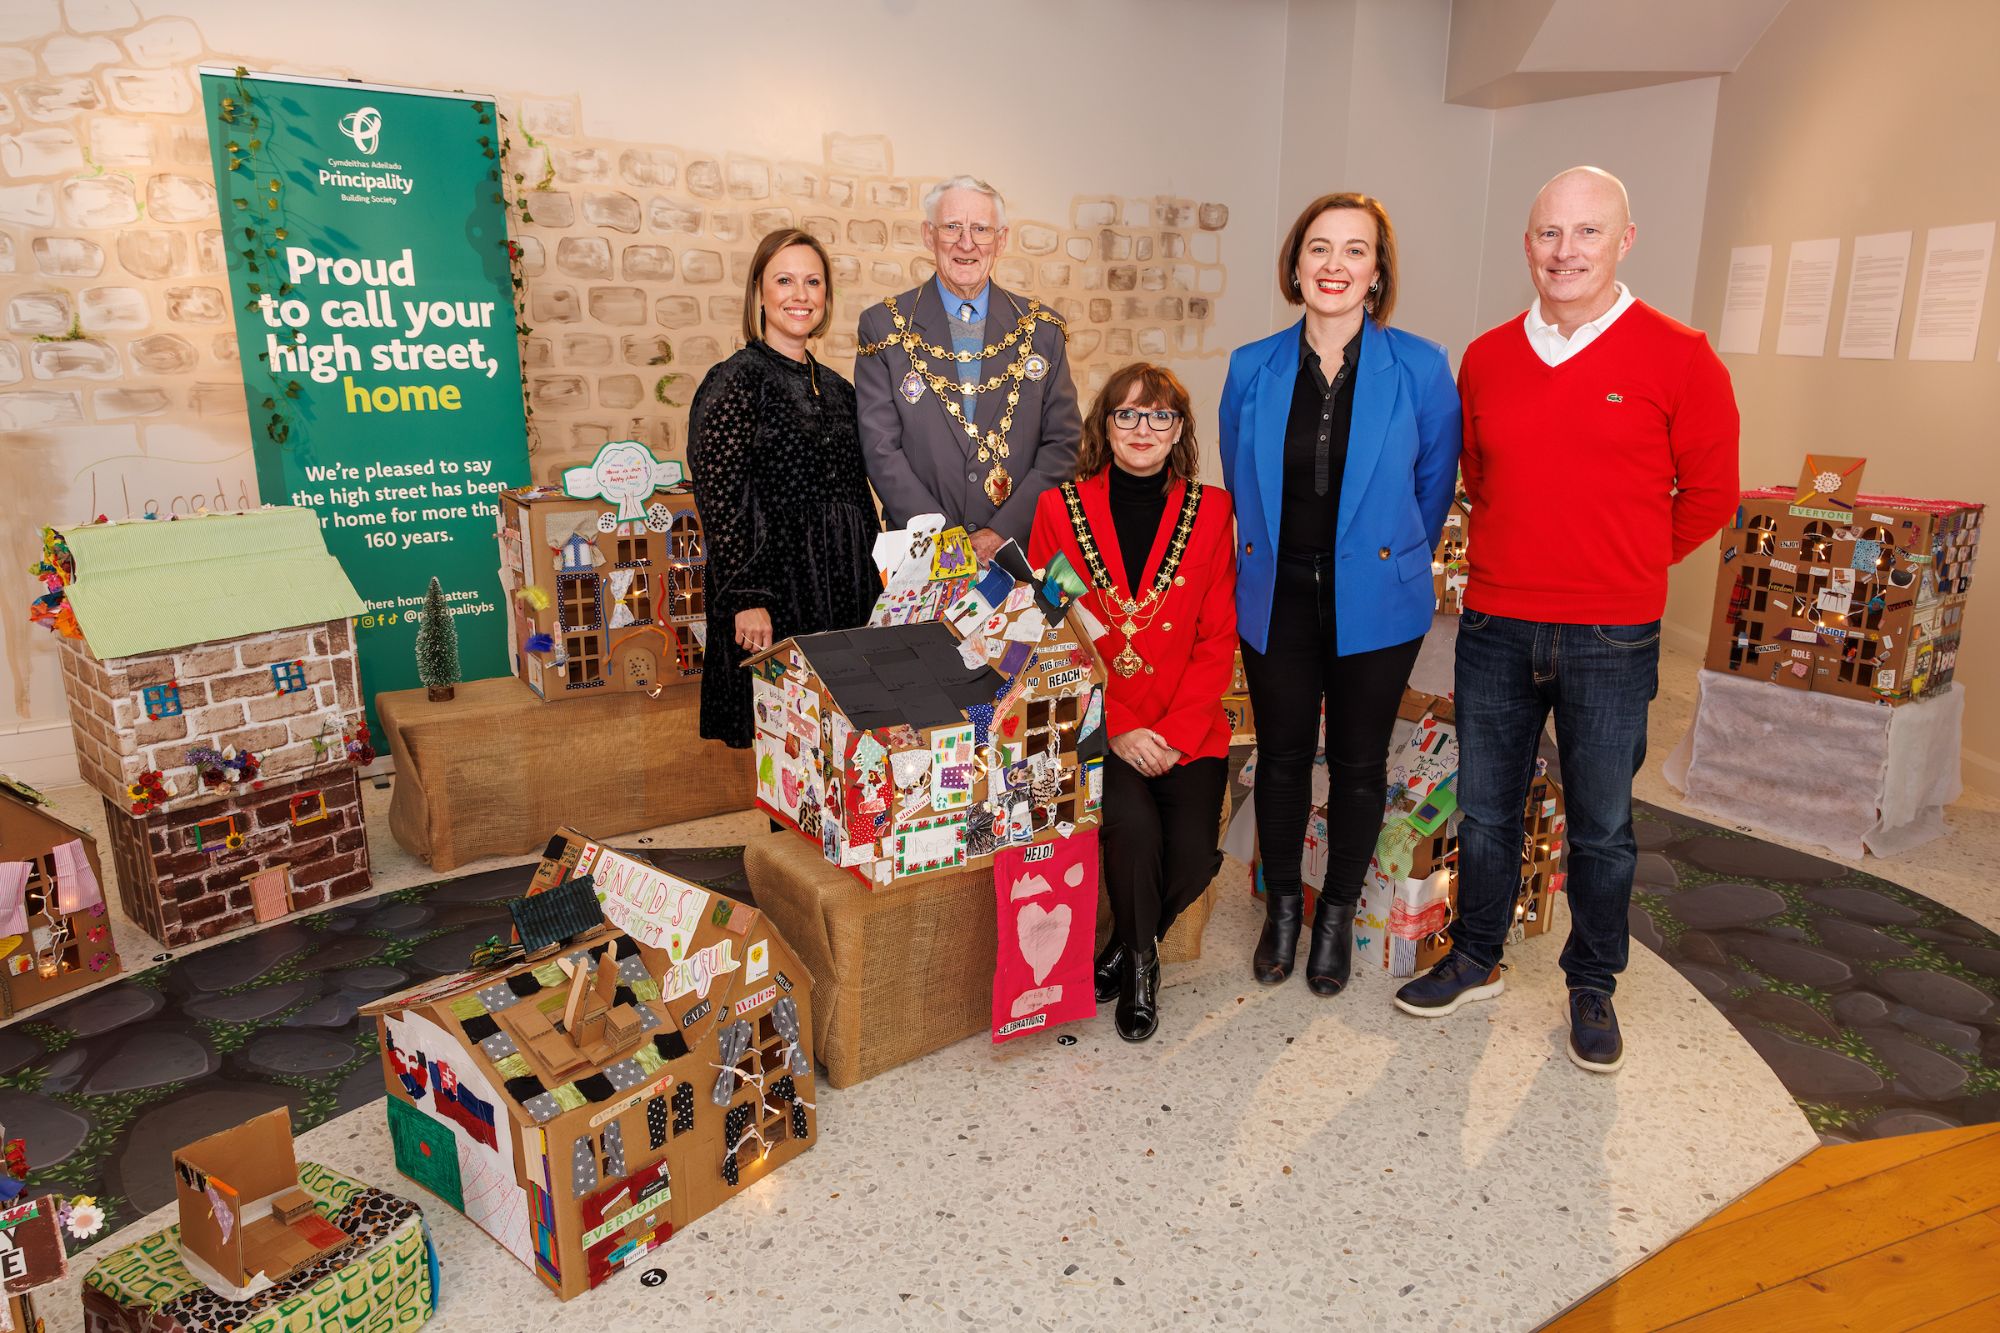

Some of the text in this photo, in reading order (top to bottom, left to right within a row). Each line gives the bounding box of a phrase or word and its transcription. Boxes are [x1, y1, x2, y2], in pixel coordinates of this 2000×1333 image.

[328, 158, 402, 170] Cymdeithas Adeiladu
[319, 169, 413, 194] Principality
[341, 193, 397, 205] Building Society
[286, 247, 416, 287] Proud
[258, 289, 495, 339] to call your
[266, 333, 499, 383] high street,
[343, 375, 463, 414] home
[364, 459, 435, 483] pleased
[439, 459, 459, 473] to
[463, 459, 492, 477] say
[291, 479, 508, 508] the high street has been
[333, 510, 387, 529] home
[390, 507, 418, 524] for
[421, 503, 467, 522] more
[471, 501, 500, 518] tha
[1790, 508, 1851, 525] EVERYONE
[364, 529, 454, 550] 160 years.
[1770, 559, 1796, 573] MODEL
[365, 597, 395, 610] here
[1815, 626, 1845, 638] INSIDE
[1791, 650, 1811, 659] ROLE
[1040, 661, 1053, 672] BIG
[1027, 678, 1039, 687] NO
[1049, 669, 1080, 687] REACH
[1024, 844, 1053, 862] HELO!
[776, 974, 792, 992] WELSH
[736, 988, 775, 1012] Wales
[683, 1002, 711, 1027] CALM
[1059, 1036, 1075, 1045] 2
[583, 1189, 669, 1246] EVERYONE
[642, 1271, 662, 1285] 3
